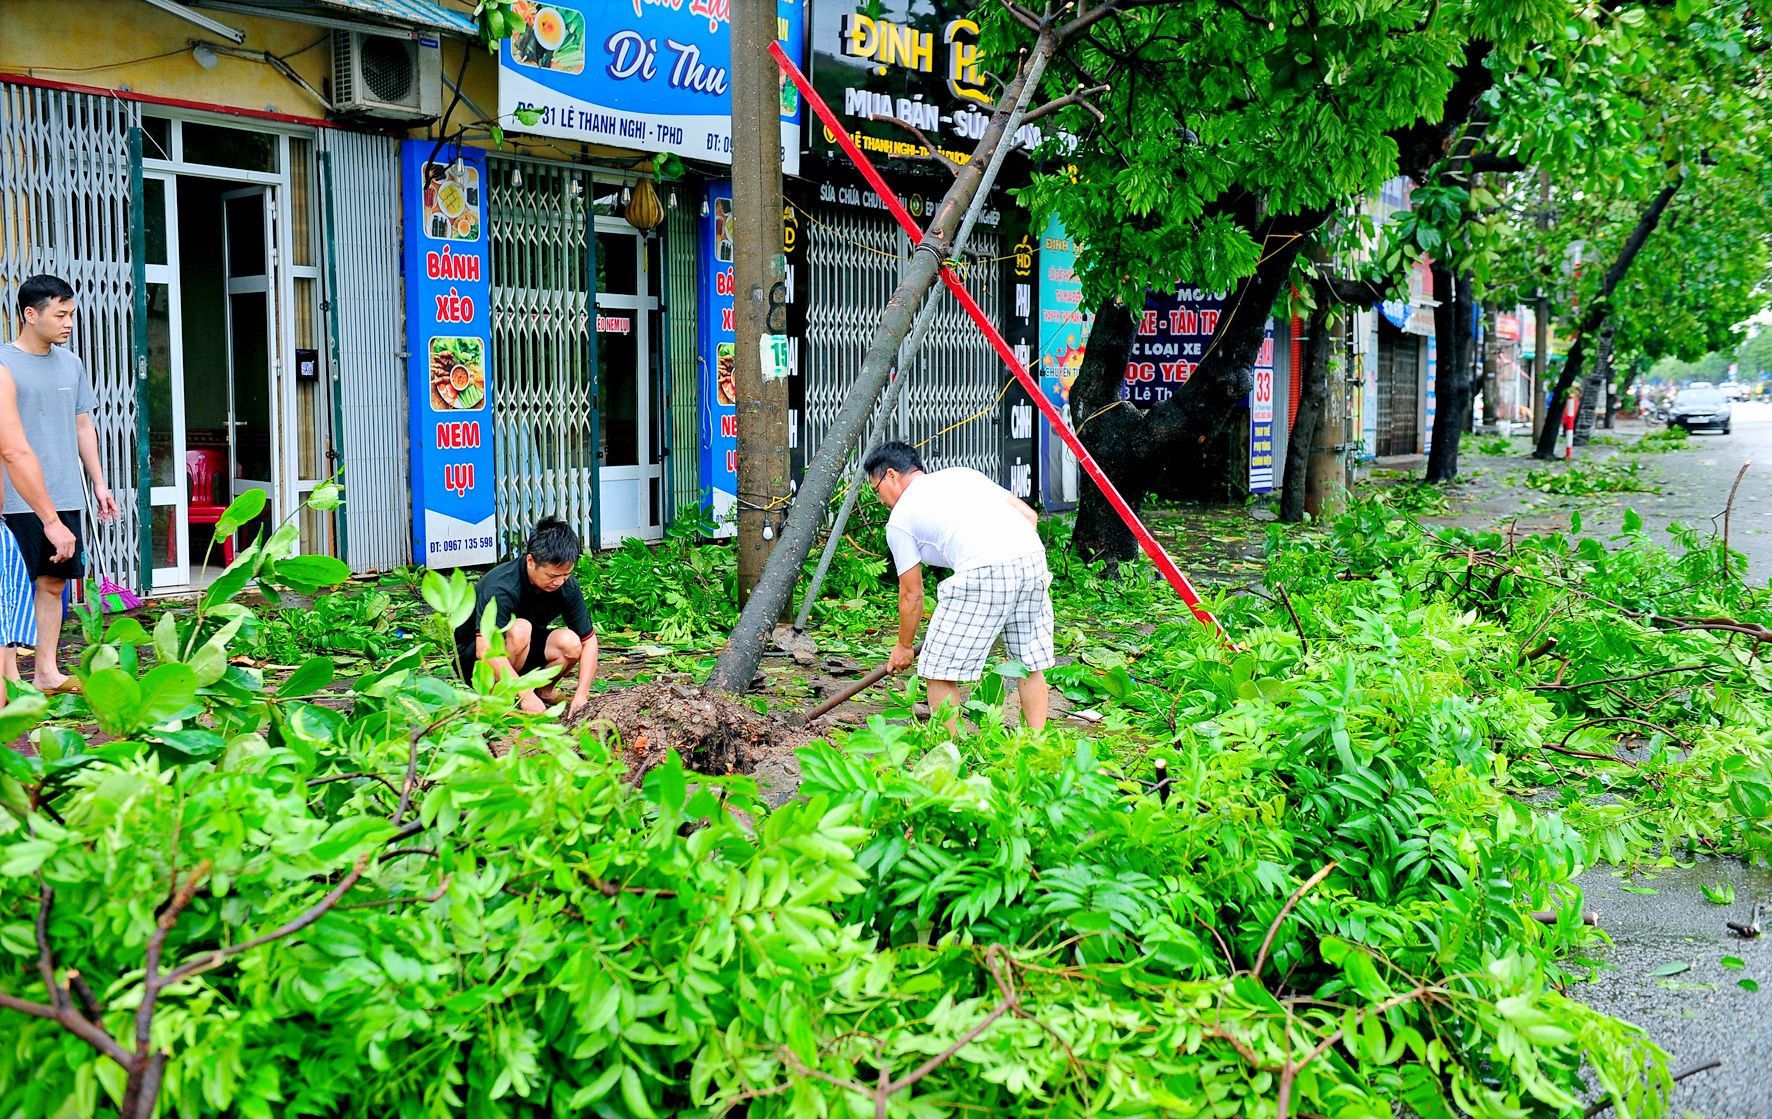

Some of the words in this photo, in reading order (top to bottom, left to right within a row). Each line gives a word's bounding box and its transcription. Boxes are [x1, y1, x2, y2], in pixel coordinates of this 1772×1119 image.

[845, 13, 933, 76] ĐỊNH
[605, 29, 658, 80] Dì
[666, 38, 728, 95] Thu
[542, 105, 556, 125] 31
[560, 105, 575, 128] LÊ
[578, 111, 616, 135] THANH
[619, 118, 646, 143] NGHỊ
[656, 124, 683, 145] TPHD
[845, 87, 894, 118] MUA
[896, 93, 939, 132] BÁN
[862, 136, 893, 153] THANH
[428, 246, 480, 281] BÁNH
[1016, 253, 1031, 269] HD
[436, 289, 474, 323] XÈO
[1144, 343, 1178, 358] LOẠI
[1182, 343, 1202, 355] XE
[1135, 387, 1152, 400] Lê
[1256, 372, 1271, 402] 33
[437, 422, 480, 449] NEM
[1010, 398, 1032, 439] CHÍNH
[445, 464, 474, 498] LỤI
[443, 539, 462, 552] 0967
[465, 537, 478, 550] 135
[479, 536, 493, 549] 598
